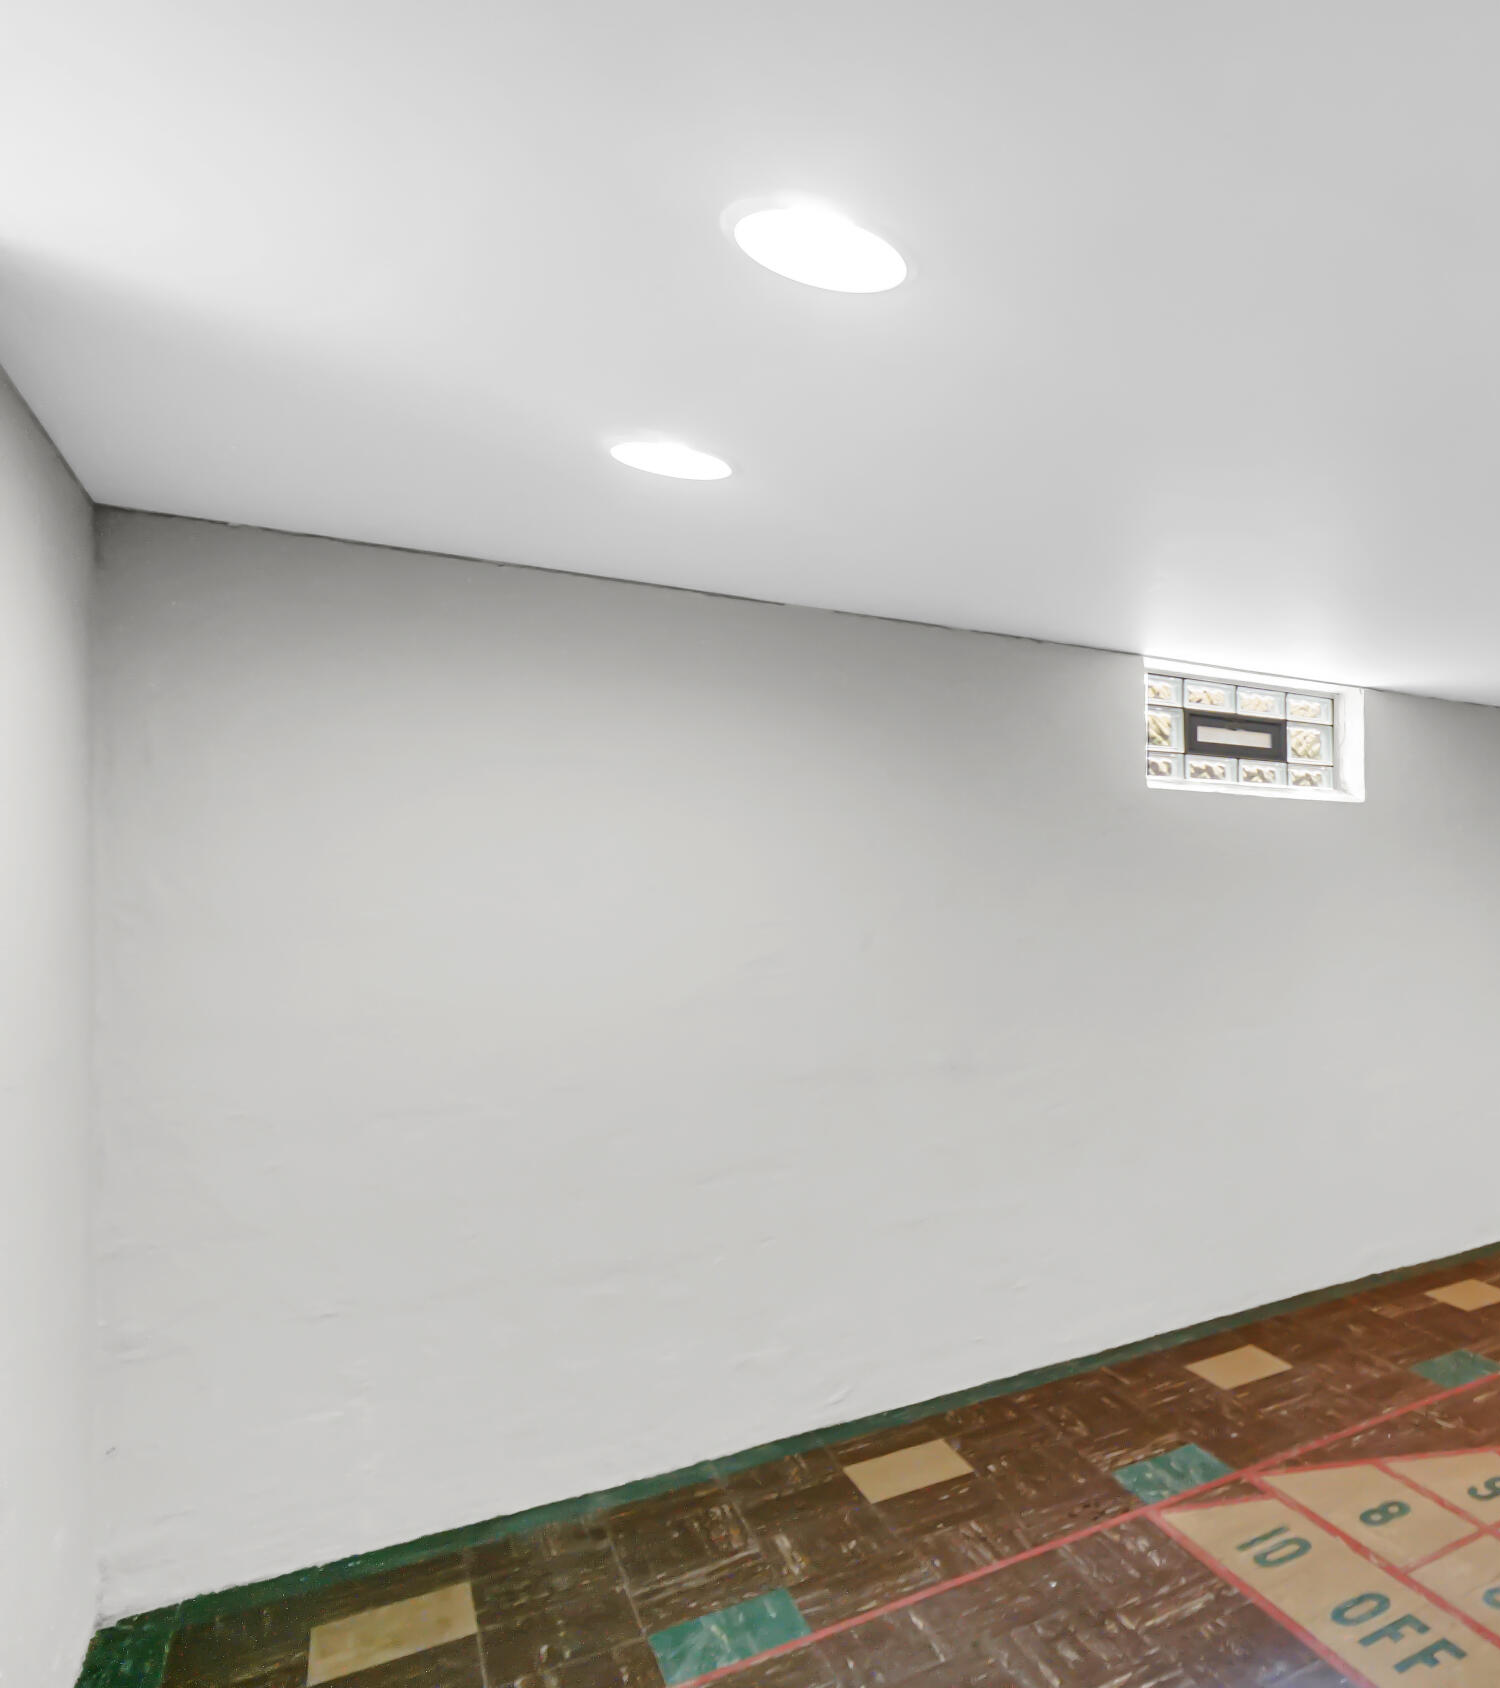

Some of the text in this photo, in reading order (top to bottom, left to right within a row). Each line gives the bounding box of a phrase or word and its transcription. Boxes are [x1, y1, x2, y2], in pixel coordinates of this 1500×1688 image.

[1359, 1499, 1412, 1528] 8
[1236, 1525, 1467, 1675] 10 OFF
